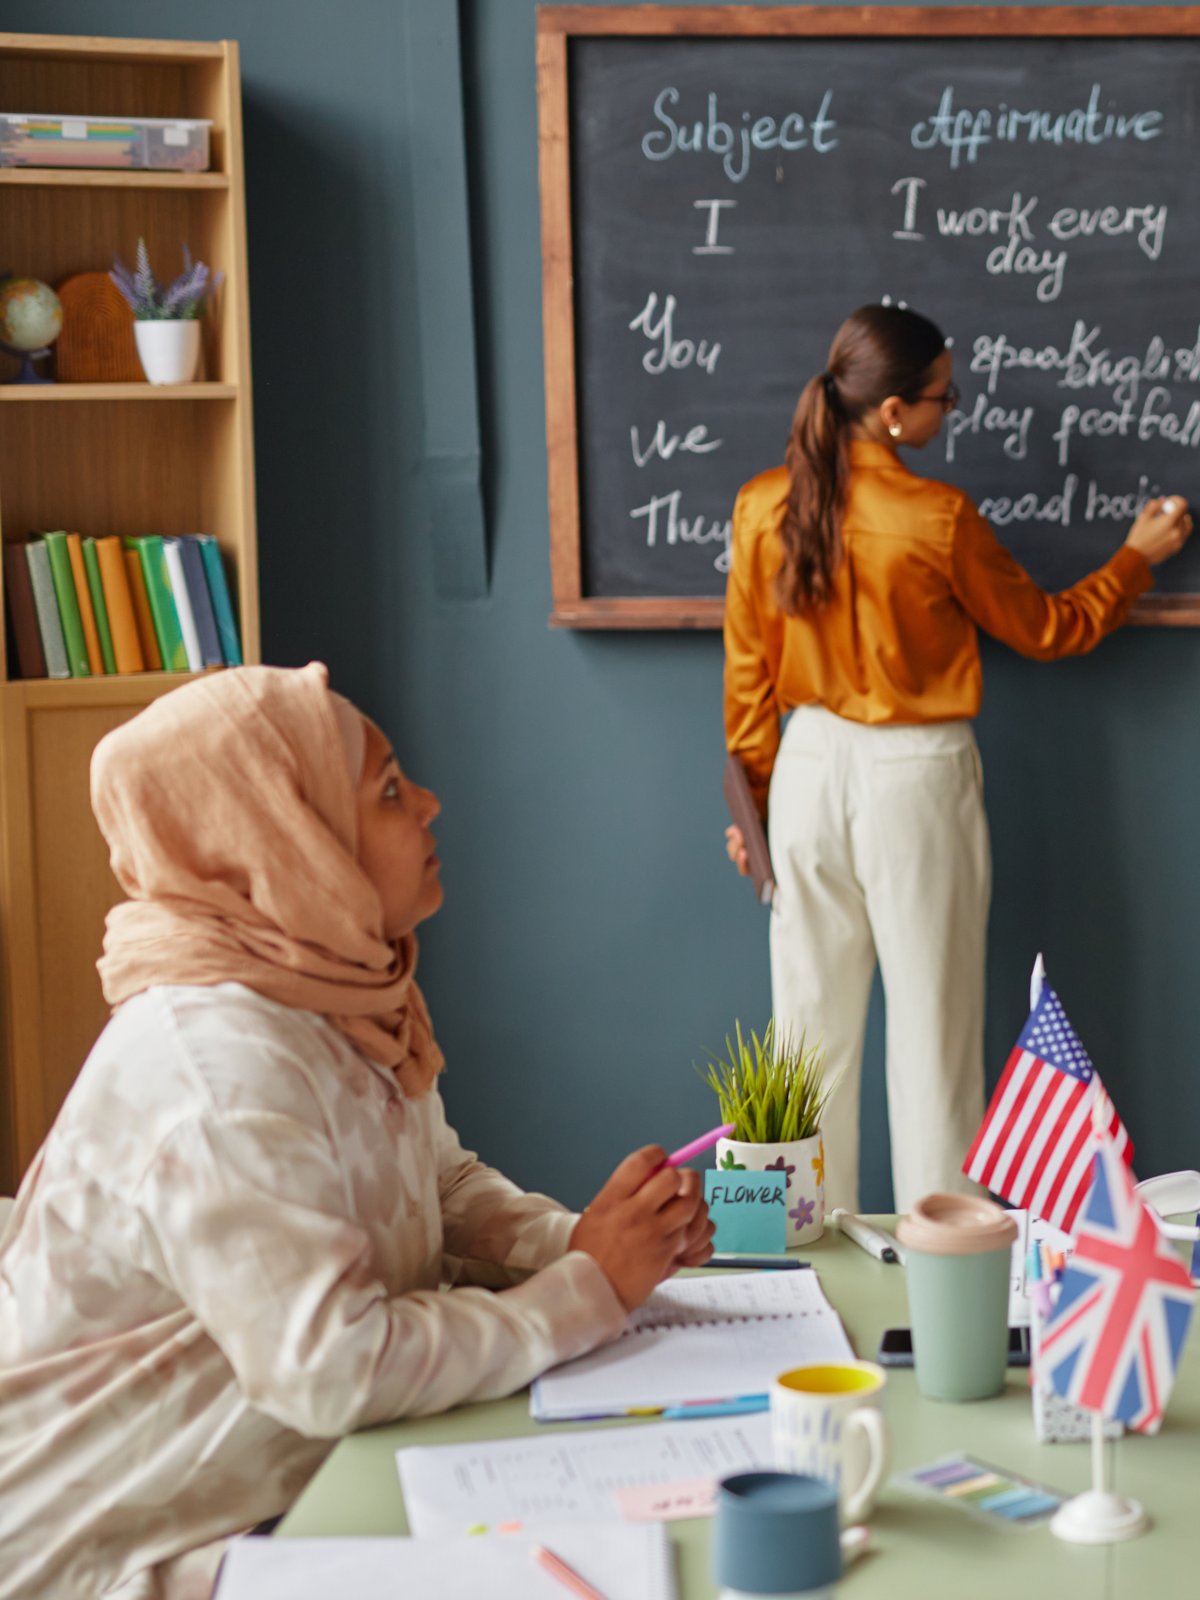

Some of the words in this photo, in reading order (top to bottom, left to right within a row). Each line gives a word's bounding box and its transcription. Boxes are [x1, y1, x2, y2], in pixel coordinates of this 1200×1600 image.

[641, 86, 838, 182] Subject
[693, 199, 737, 254] I
[891, 176, 927, 241] I
[937, 192, 1035, 241] work
[1048, 203, 1168, 260] every
[985, 231, 1068, 303] day
[628, 291, 722, 375] You
[631, 419, 724, 468] We
[945, 392, 1034, 463] play
[629, 490, 733, 574] They
